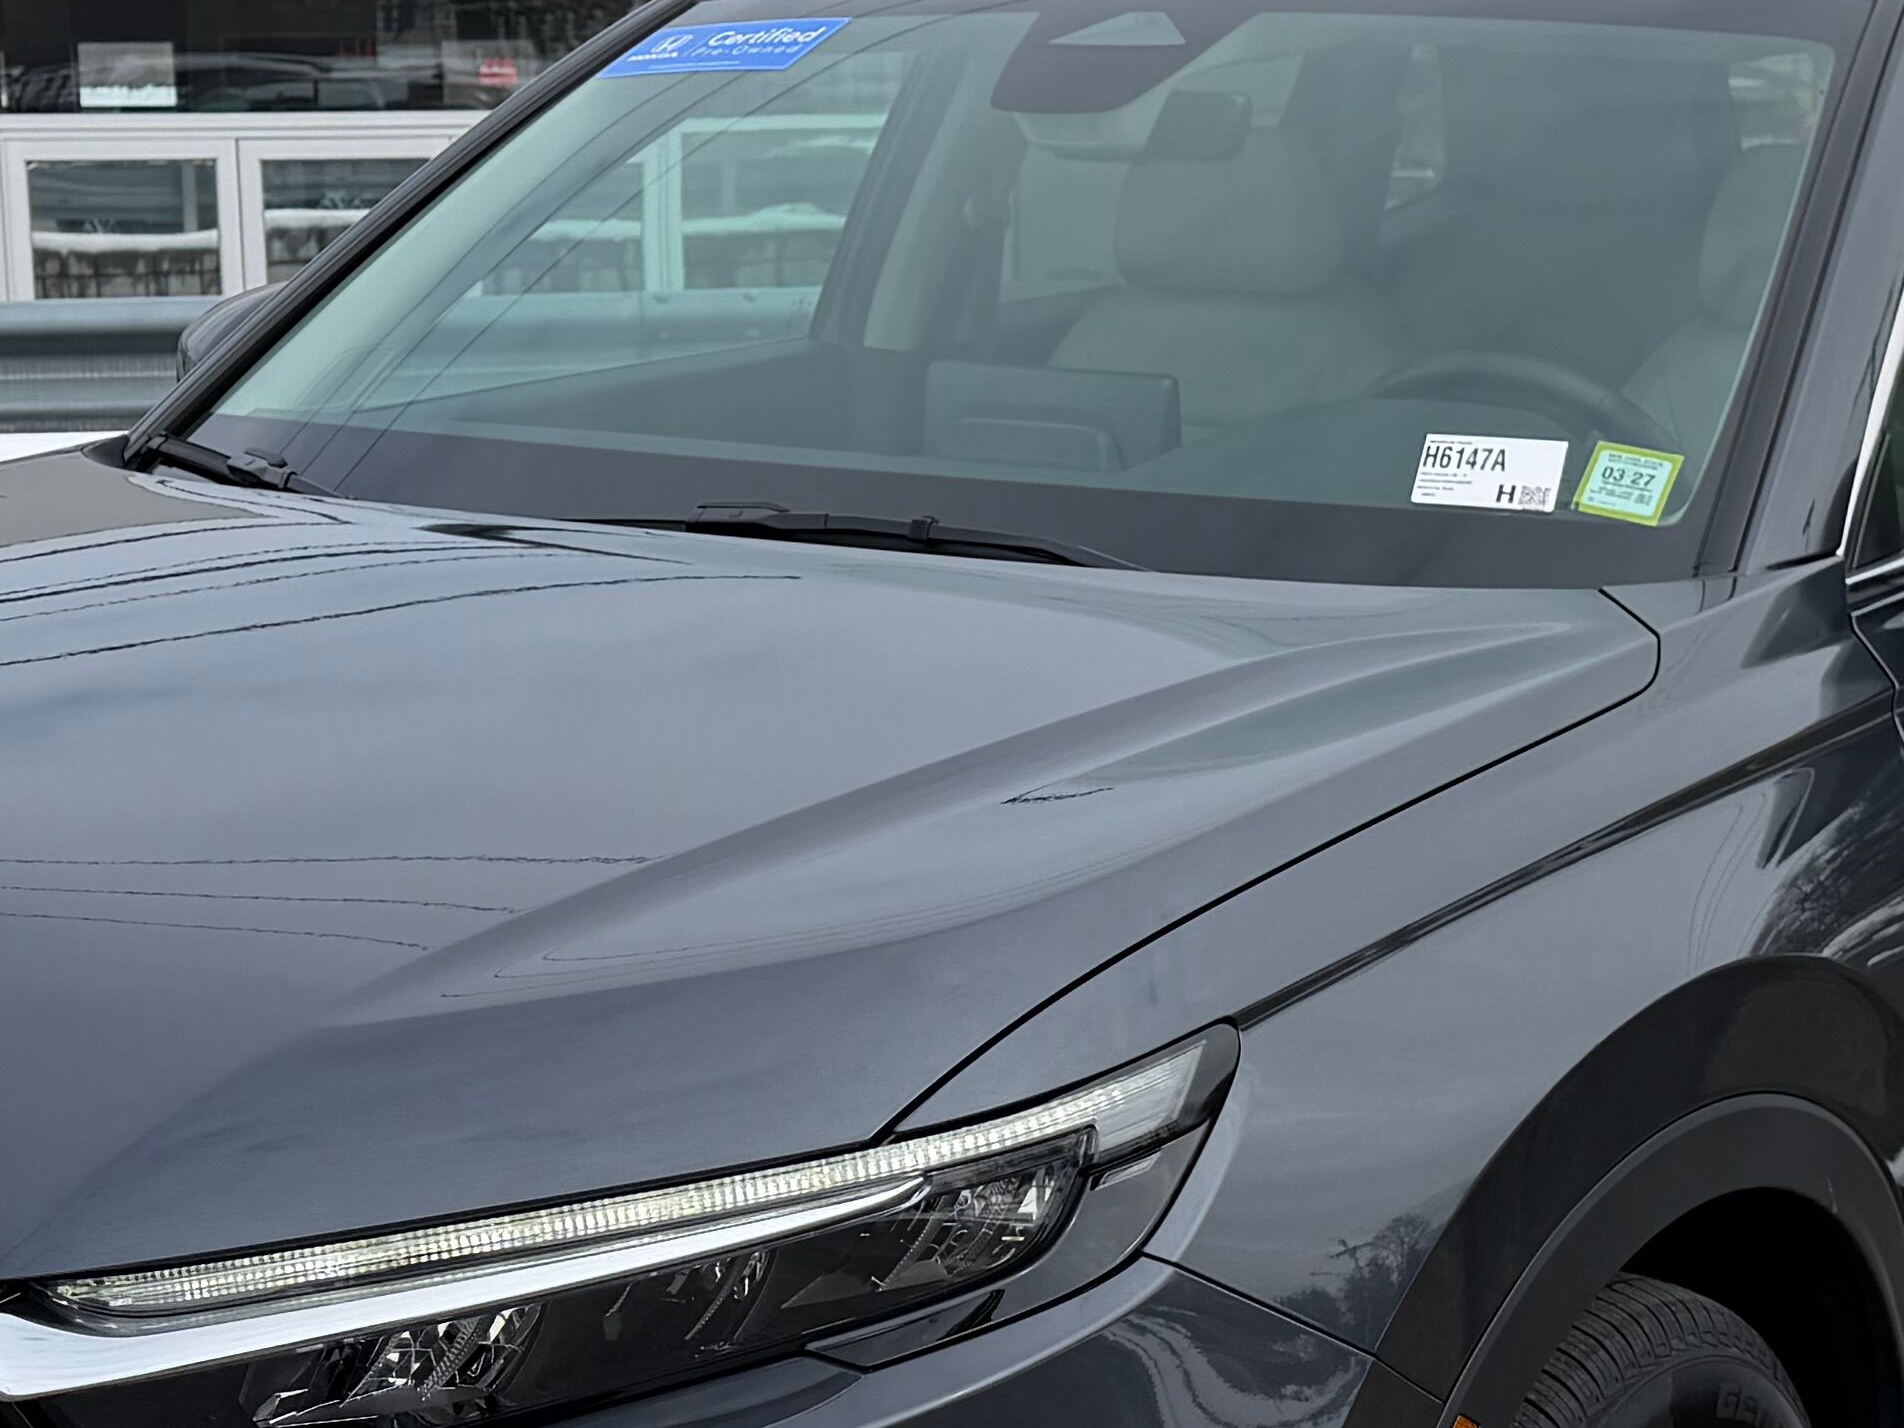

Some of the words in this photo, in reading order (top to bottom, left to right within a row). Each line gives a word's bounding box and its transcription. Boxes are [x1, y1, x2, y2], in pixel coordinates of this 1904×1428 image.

[708, 26, 828, 47] Certified
[1422, 445, 1506, 472] H6147A
[1602, 466, 1625, 482] 03
[1630, 471, 1656, 487] 27
[1496, 484, 1516, 503] H
